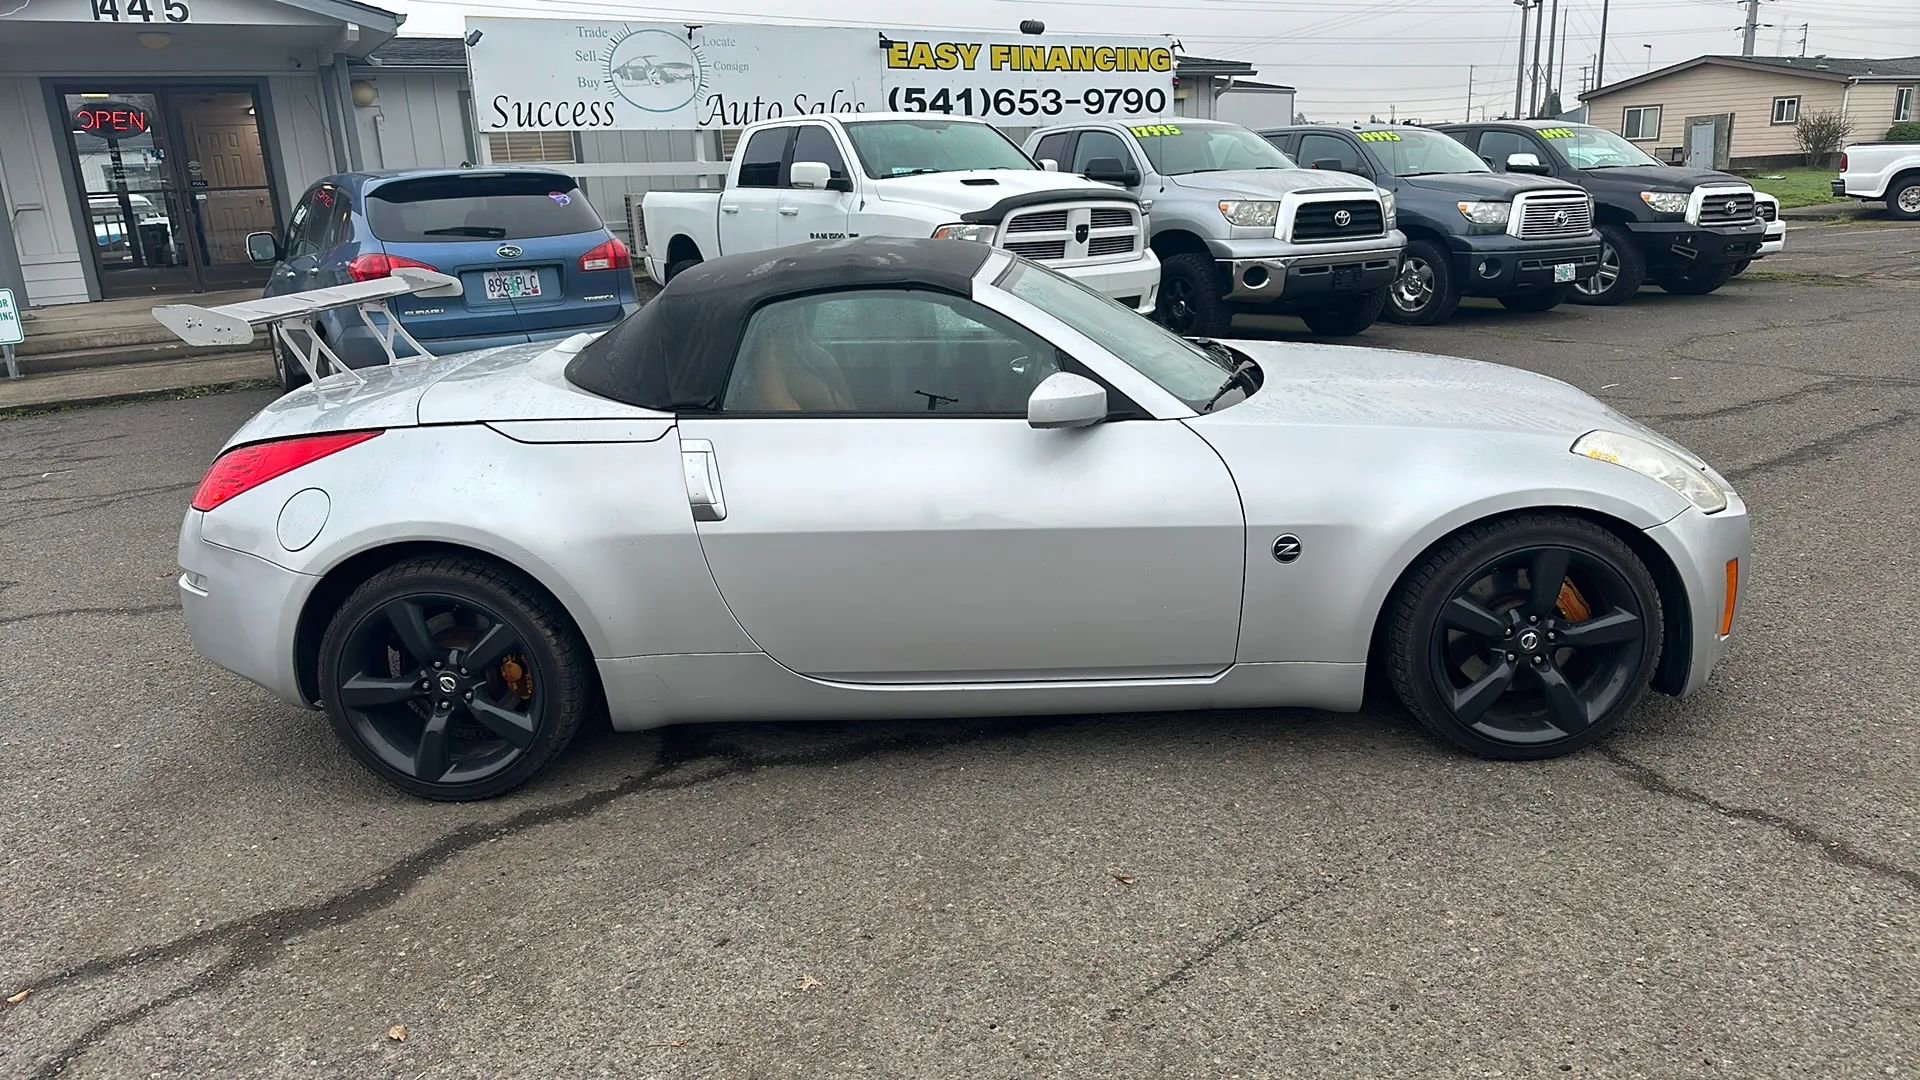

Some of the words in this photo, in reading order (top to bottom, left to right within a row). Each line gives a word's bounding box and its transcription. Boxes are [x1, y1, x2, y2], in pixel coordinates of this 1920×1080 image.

[91, 0, 189, 22] 1445
[576, 26, 608, 38] Trade
[702, 35, 736, 47] Locate
[575, 50, 597, 61] Sell
[887, 41, 982, 70] EASY
[990, 44, 1171, 72] FINANCING
[713, 61, 749, 73] Consign
[577, 77, 600, 90] Buy
[491, 95, 615, 128] Success
[699, 93, 783, 126] Auto
[793, 89, 865, 115] Sales
[888, 87, 1166, 116] (541)653-9790
[77, 110, 145, 131] OPEN
[1130, 124, 1182, 138] 17995
[1355, 130, 1402, 143] 19995
[488, 278, 510, 293] 896
[515, 275, 538, 292] PLC
